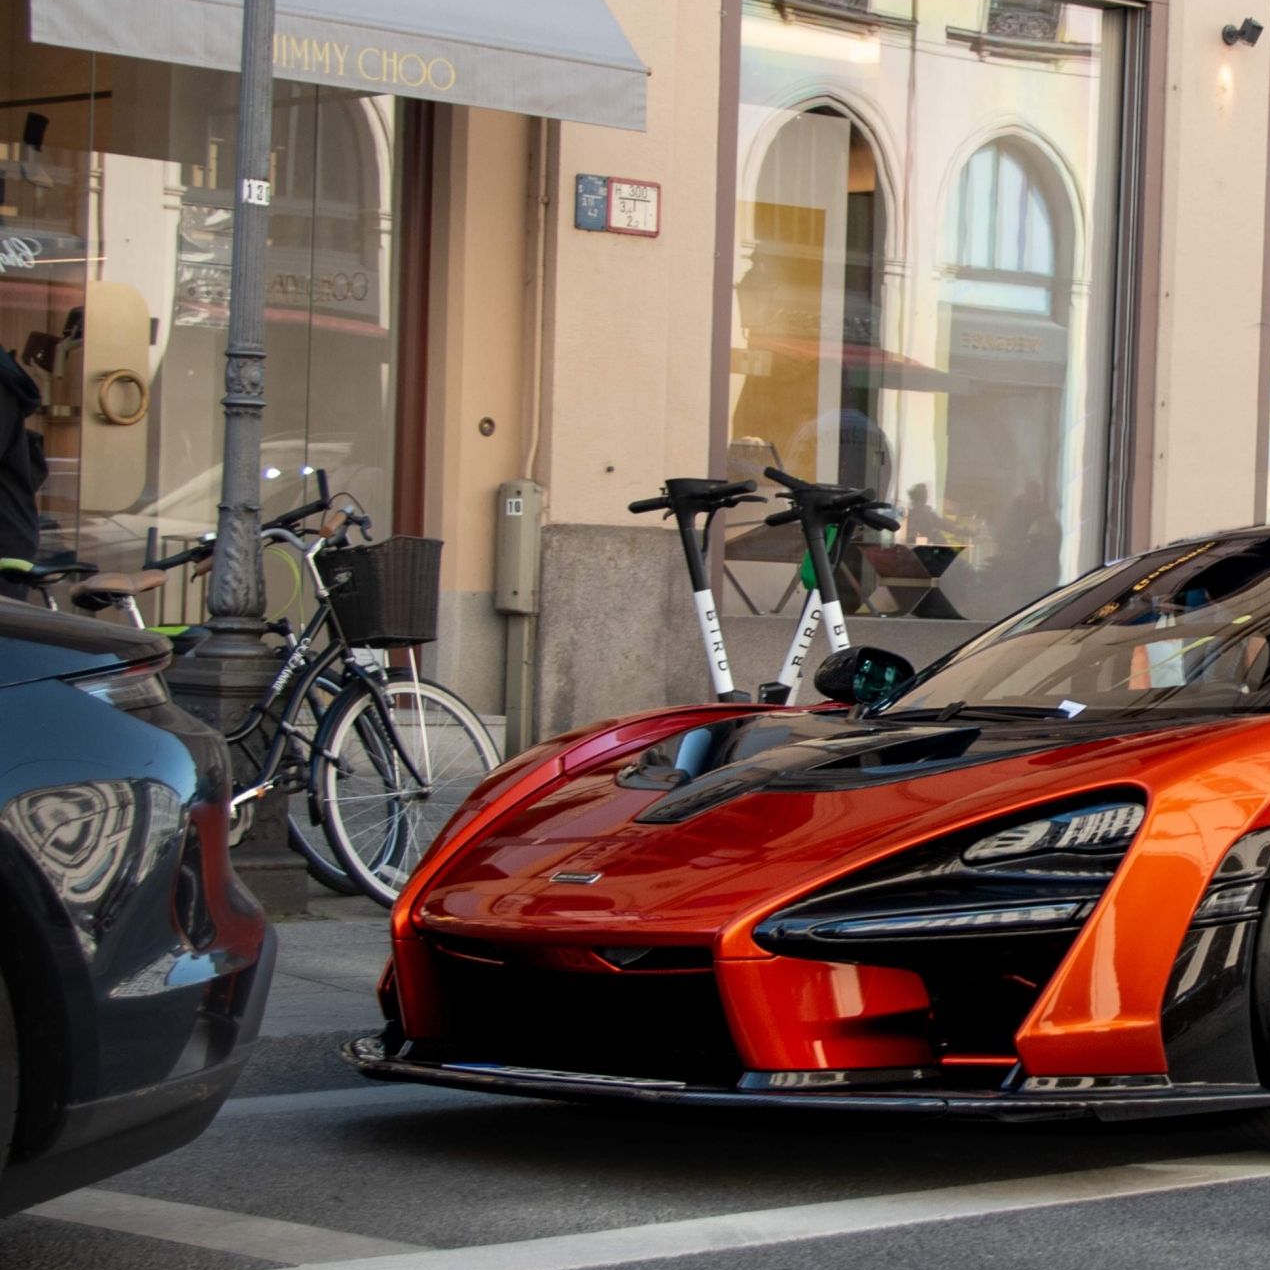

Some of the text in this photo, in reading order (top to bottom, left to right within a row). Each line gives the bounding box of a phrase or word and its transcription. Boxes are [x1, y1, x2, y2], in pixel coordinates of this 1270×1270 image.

[357, 48, 456, 91] CHOO
[628, 184, 649, 199] 300
[508, 500, 521, 513] 10
[705, 609, 729, 672] BIRD
[791, 609, 822, 668] BIRD
